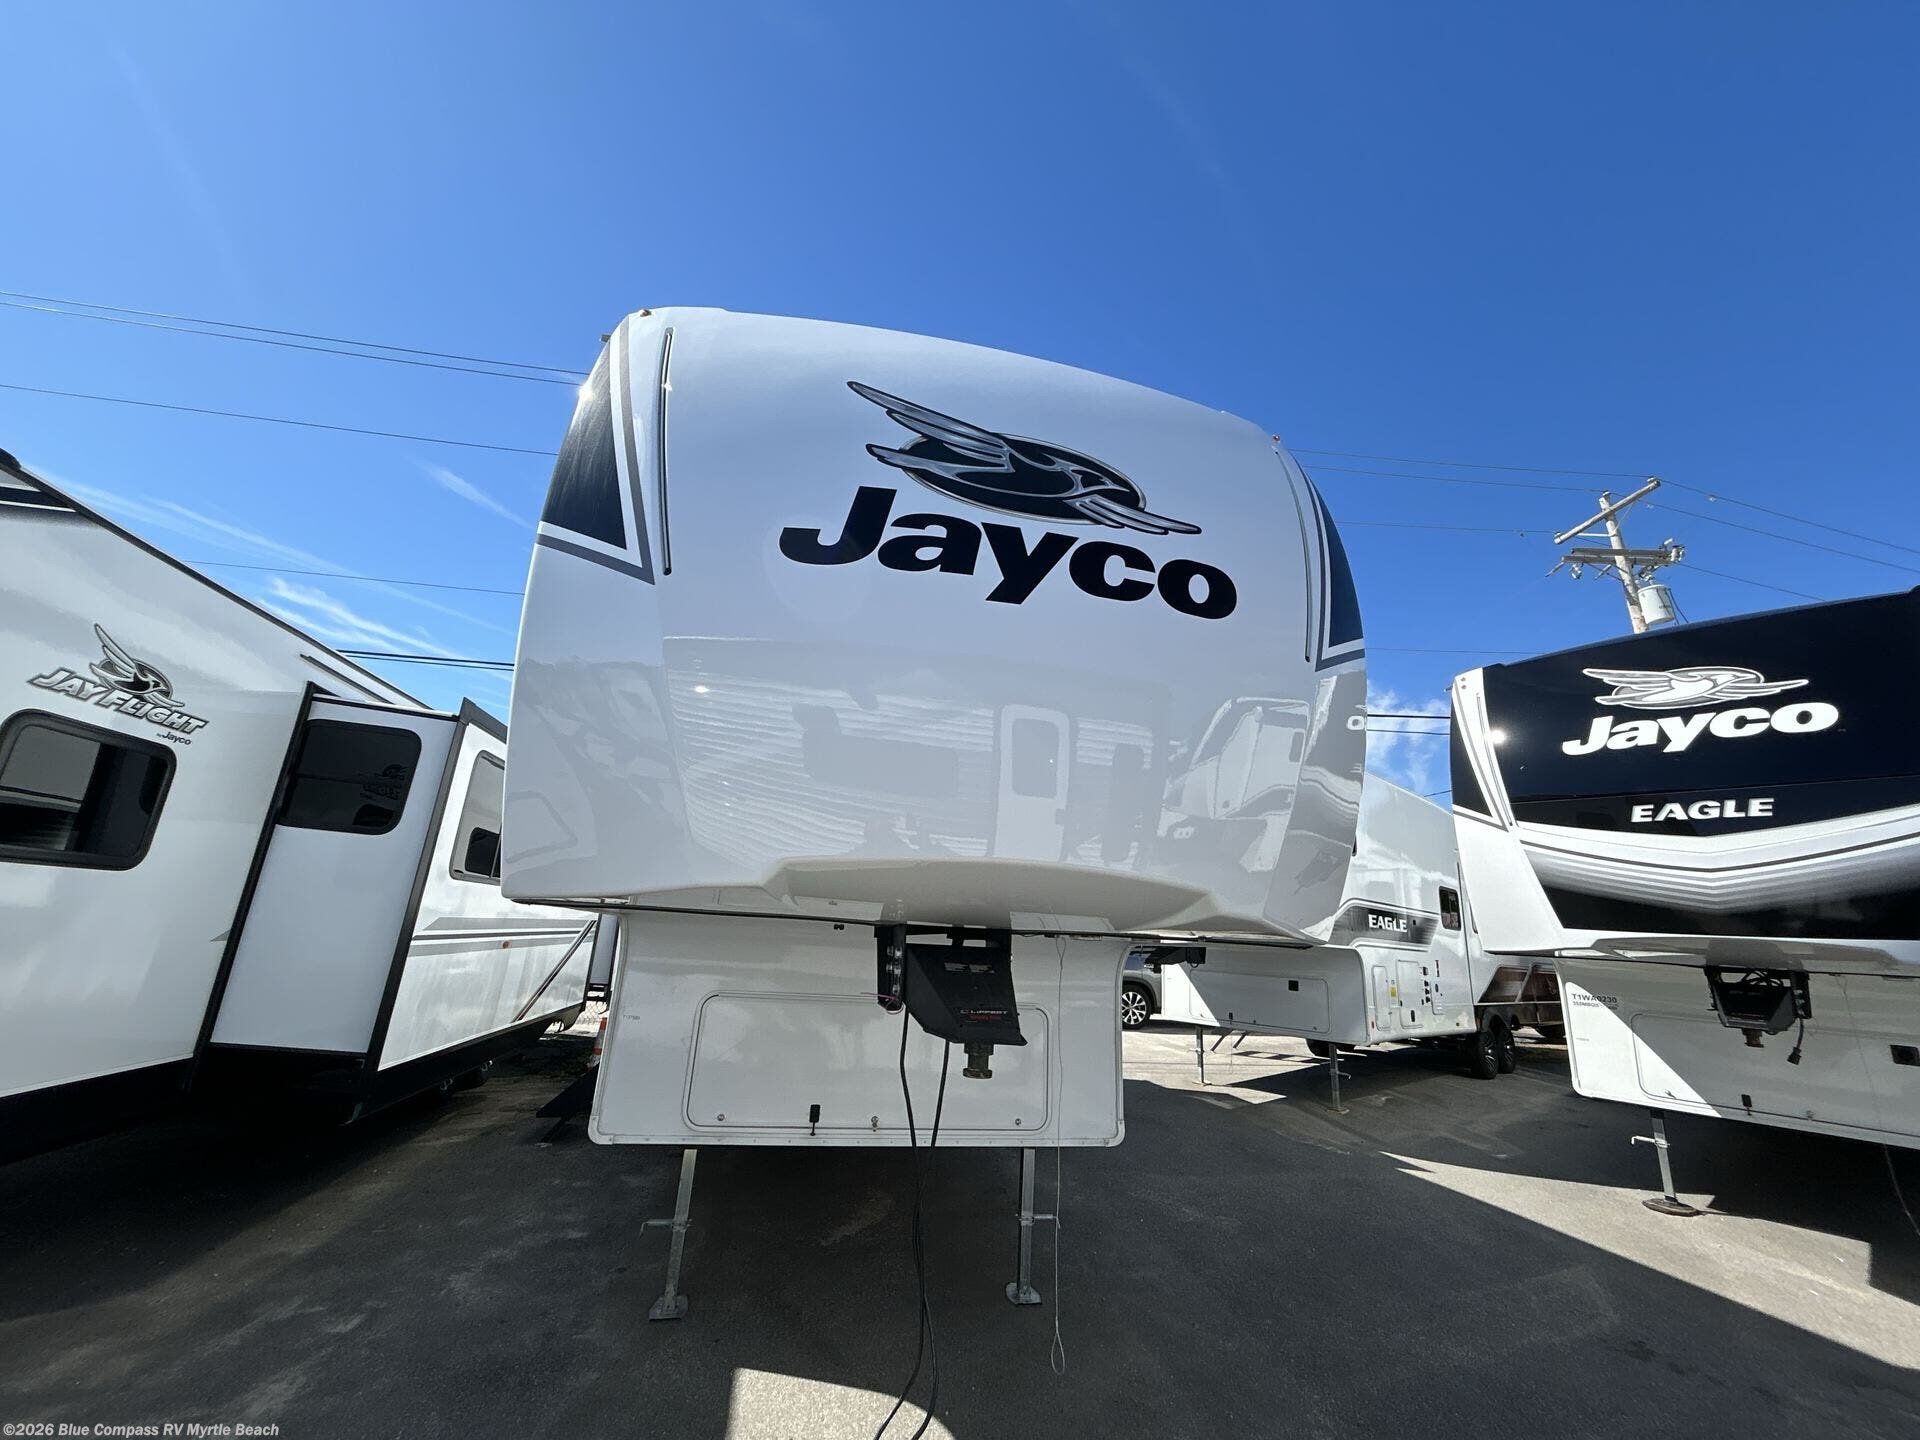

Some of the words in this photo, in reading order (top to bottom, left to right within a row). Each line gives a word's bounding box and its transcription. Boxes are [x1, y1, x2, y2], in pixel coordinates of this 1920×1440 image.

[779, 486, 1237, 620] Jayco
[28, 667, 110, 701] JAY
[95, 689, 208, 734] FLIGHT
[162, 731, 192, 745] Jayco
[1562, 702, 1839, 756] Jayco
[1631, 798, 1774, 823] EAGLE
[1368, 914, 1408, 933] EAGLE
